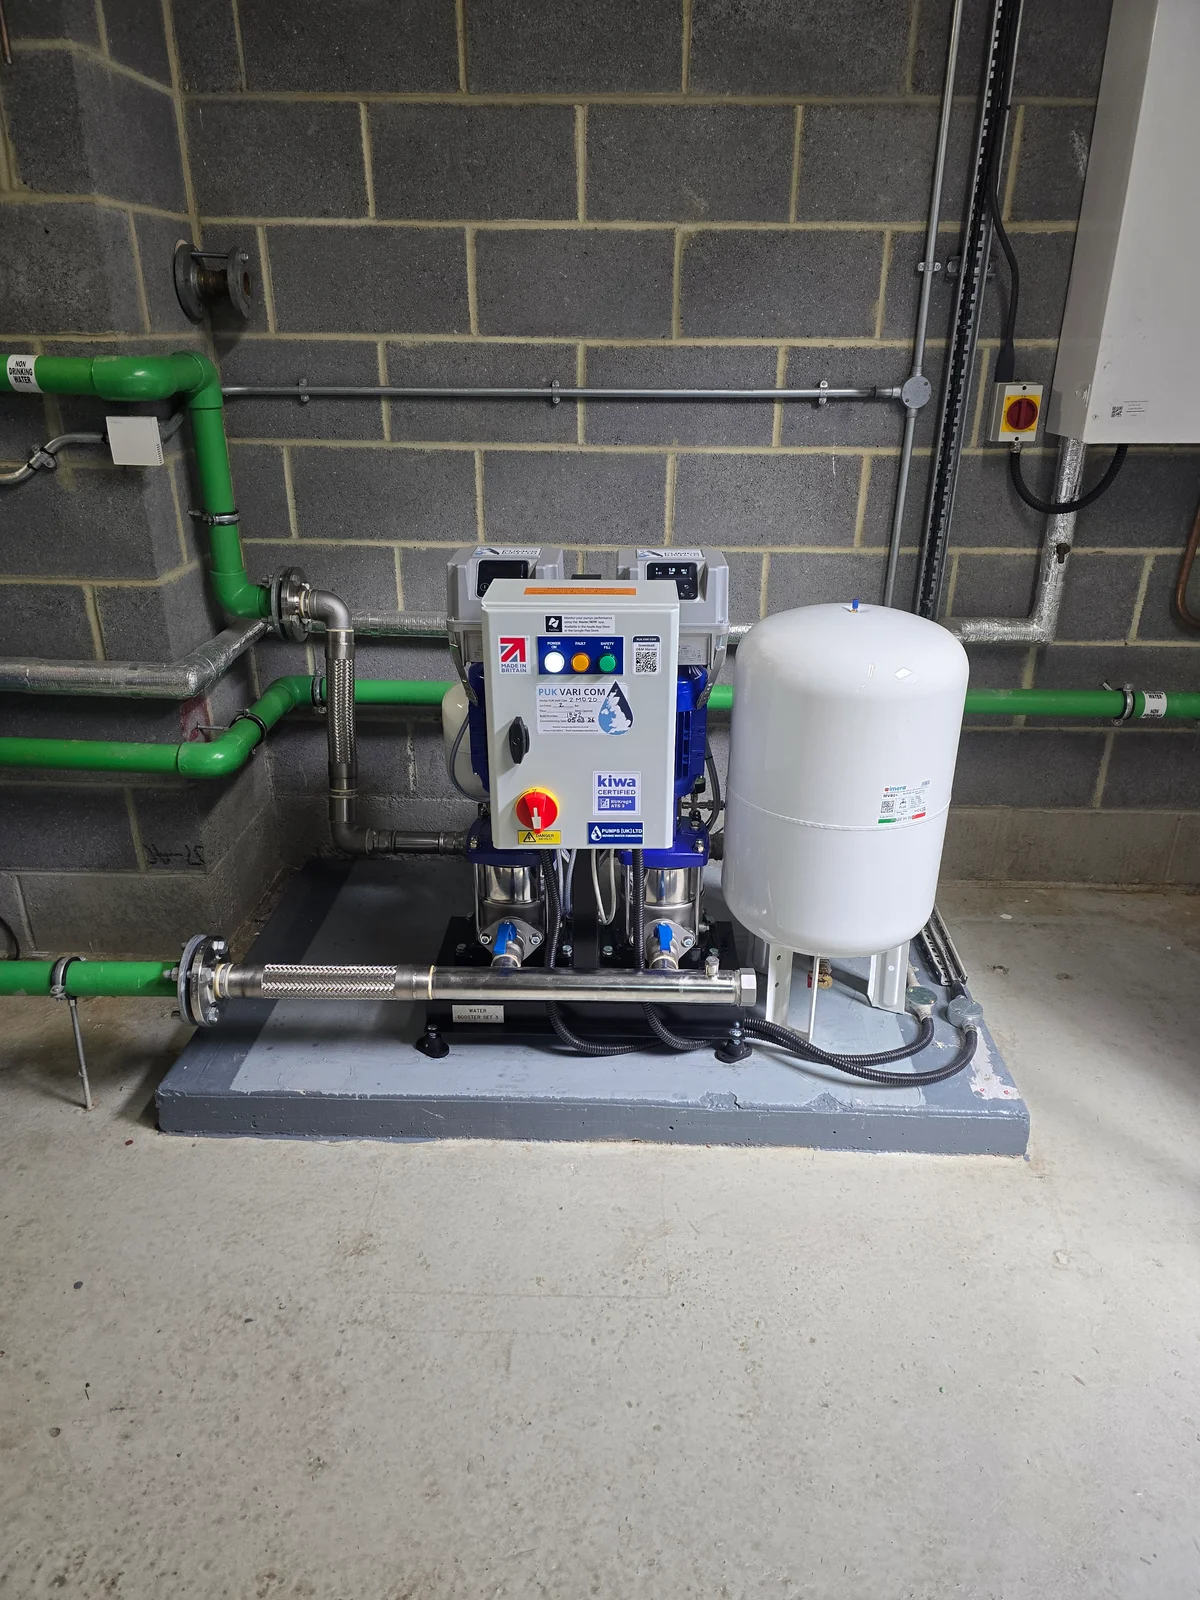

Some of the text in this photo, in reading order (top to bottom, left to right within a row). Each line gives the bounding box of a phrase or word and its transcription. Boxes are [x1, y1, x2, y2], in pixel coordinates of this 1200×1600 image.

[9, 367, 33, 376] DRINKING
[13, 375, 32, 384] WATER
[538, 688, 606, 696] PUK VARI COM
[597, 774, 636, 788] kiwa
